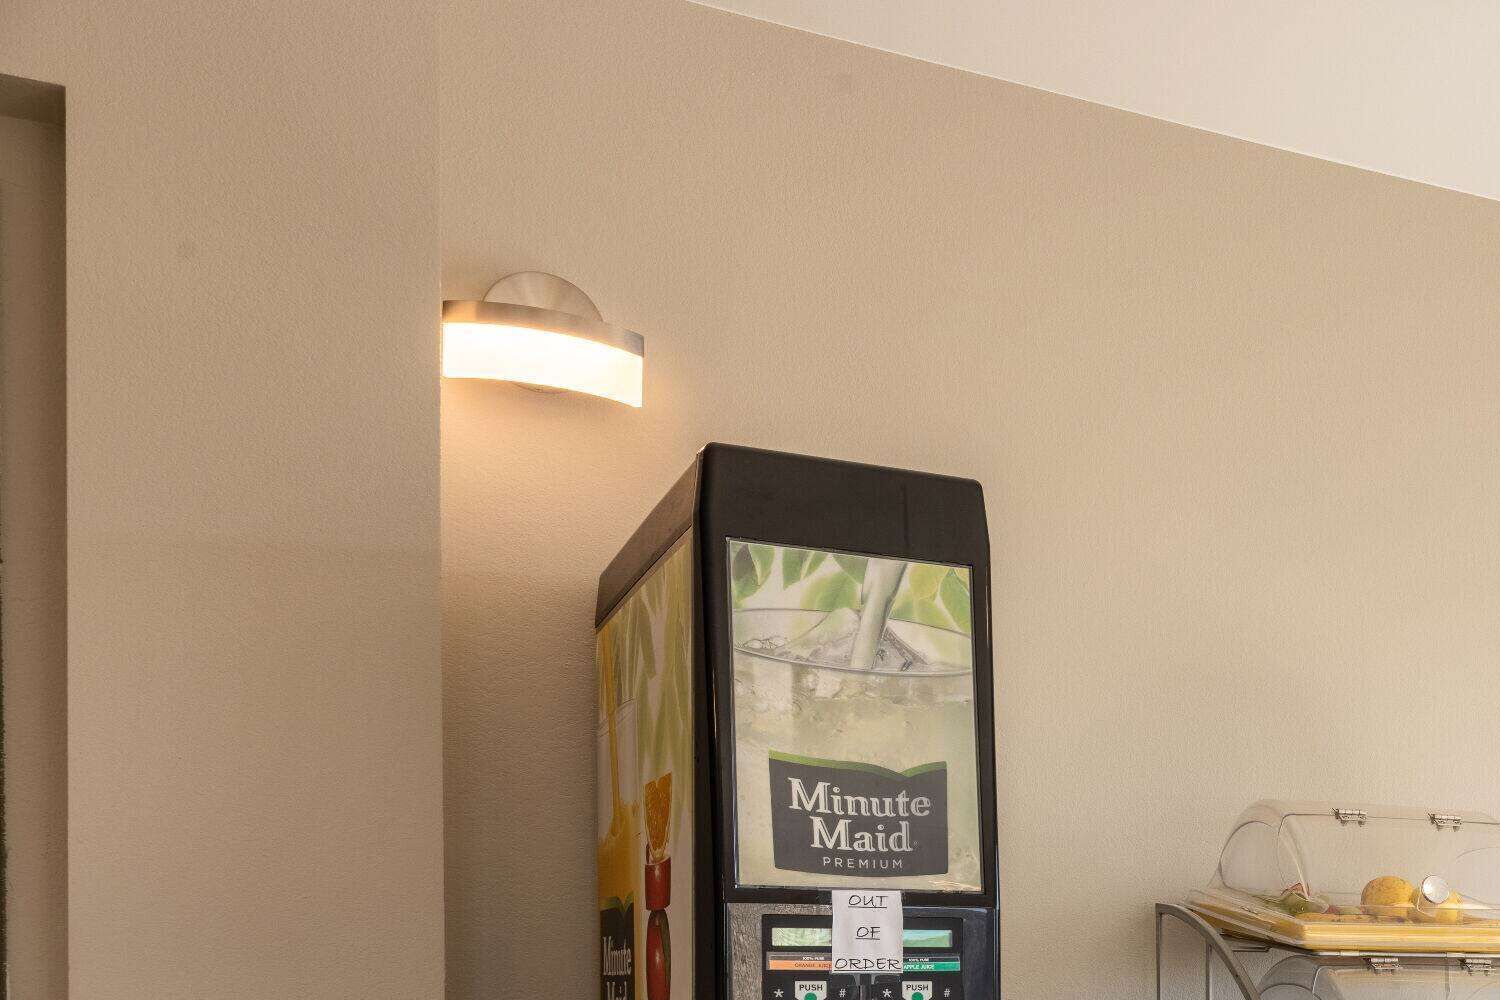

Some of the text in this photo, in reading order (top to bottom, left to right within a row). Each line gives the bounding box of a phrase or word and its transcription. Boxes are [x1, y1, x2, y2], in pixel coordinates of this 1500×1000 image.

[788, 777, 931, 817] Minute
[809, 815, 913, 852] Maid
[823, 856, 903, 869] PREMIUM
[848, 894, 888, 908] OUT
[855, 926, 880, 940] OF
[603, 936, 632, 976] Minute
[834, 958, 902, 971] ORDER
[799, 984, 824, 992] PUSH
[906, 984, 929, 992] PUSH
